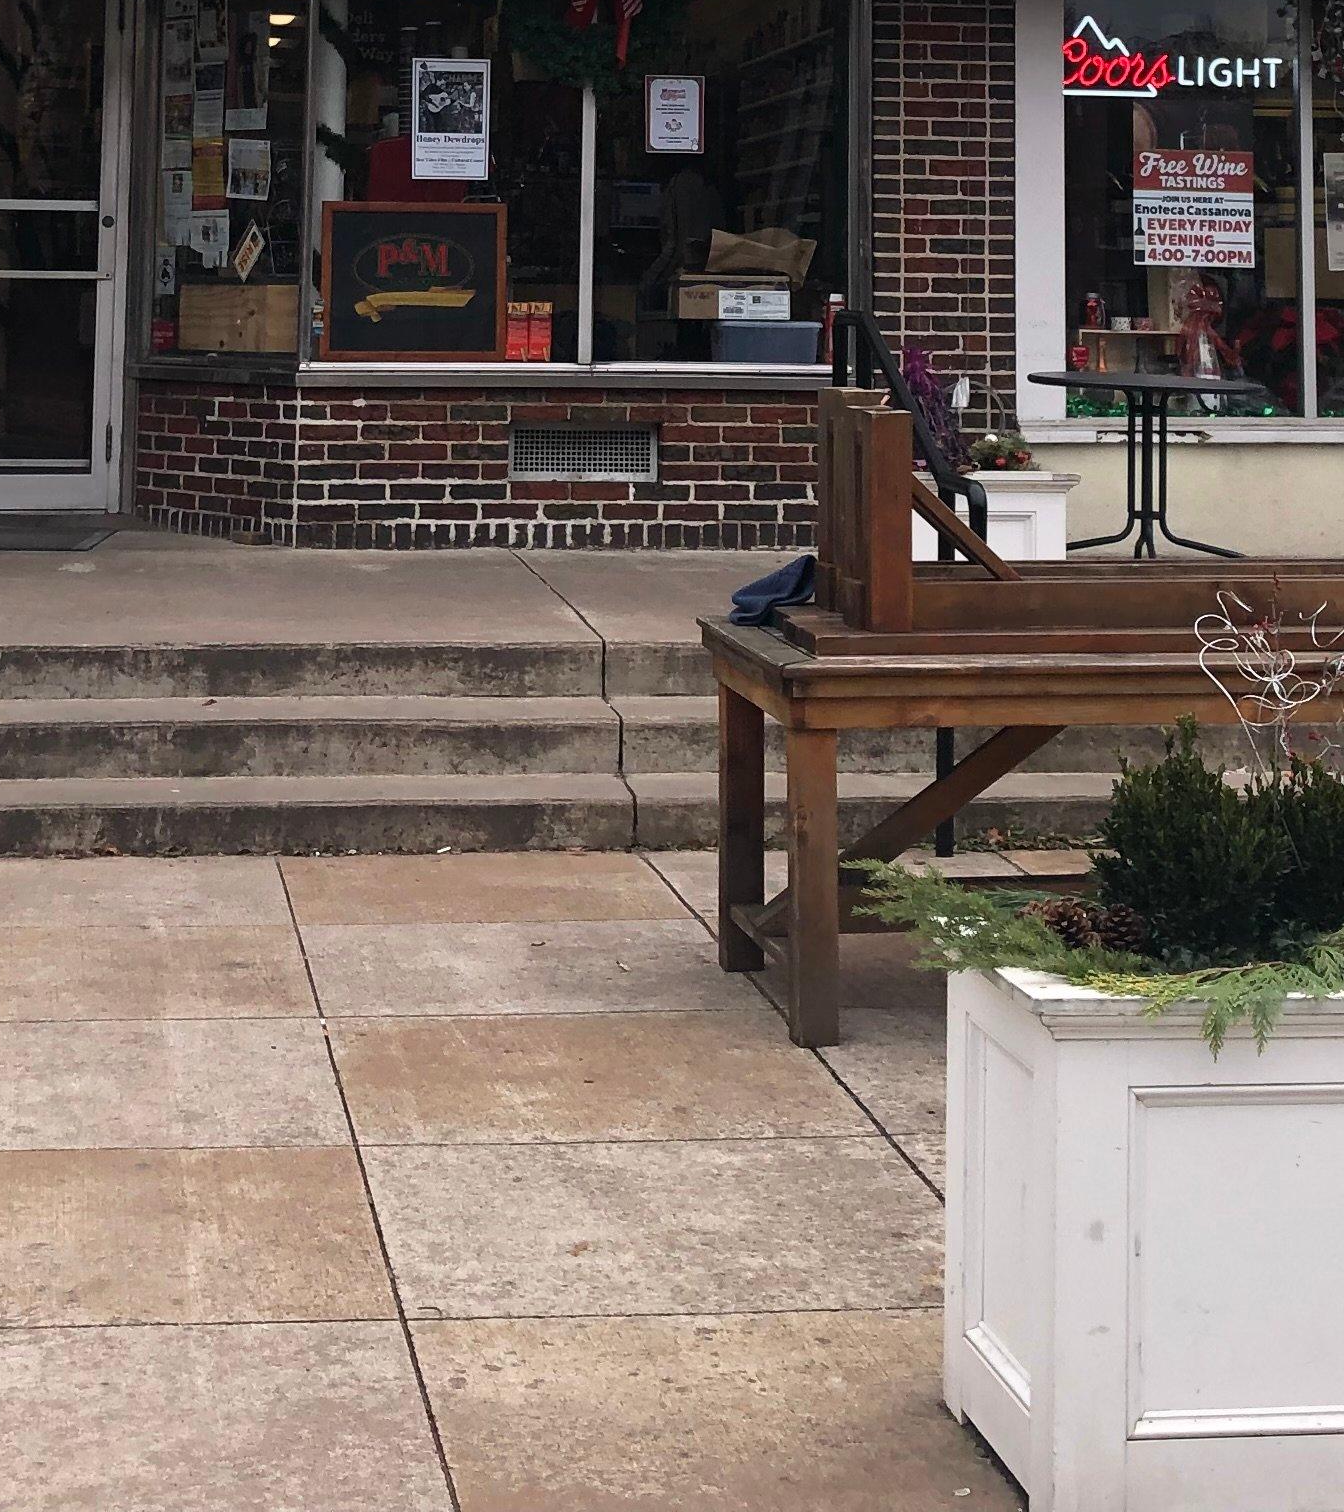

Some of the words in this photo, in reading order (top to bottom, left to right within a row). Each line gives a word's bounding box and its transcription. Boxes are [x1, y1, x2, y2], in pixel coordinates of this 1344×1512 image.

[1063, 38, 1176, 88] Coors
[1177, 55, 1283, 89] LIGHT
[443, 135, 485, 146] Dewdrops
[1139, 152, 1189, 177] Free
[1192, 153, 1249, 176] Wine
[1159, 176, 1226, 189] TASTINGS
[1162, 195, 1180, 204] JOIN
[1180, 196, 1191, 204] US
[1192, 196, 1213, 204] HERE
[1213, 197, 1225, 205] AT
[1134, 203, 1185, 216] Enoteca
[1186, 205, 1252, 218] Cassanova
[1147, 218, 1197, 232] EVERY
[1199, 219, 1253, 233] FRIDAY
[1147, 232, 1215, 248] EVENING
[376, 237, 452, 279] P&M
[1147, 248, 1252, 264] 4:00-7:00PM
